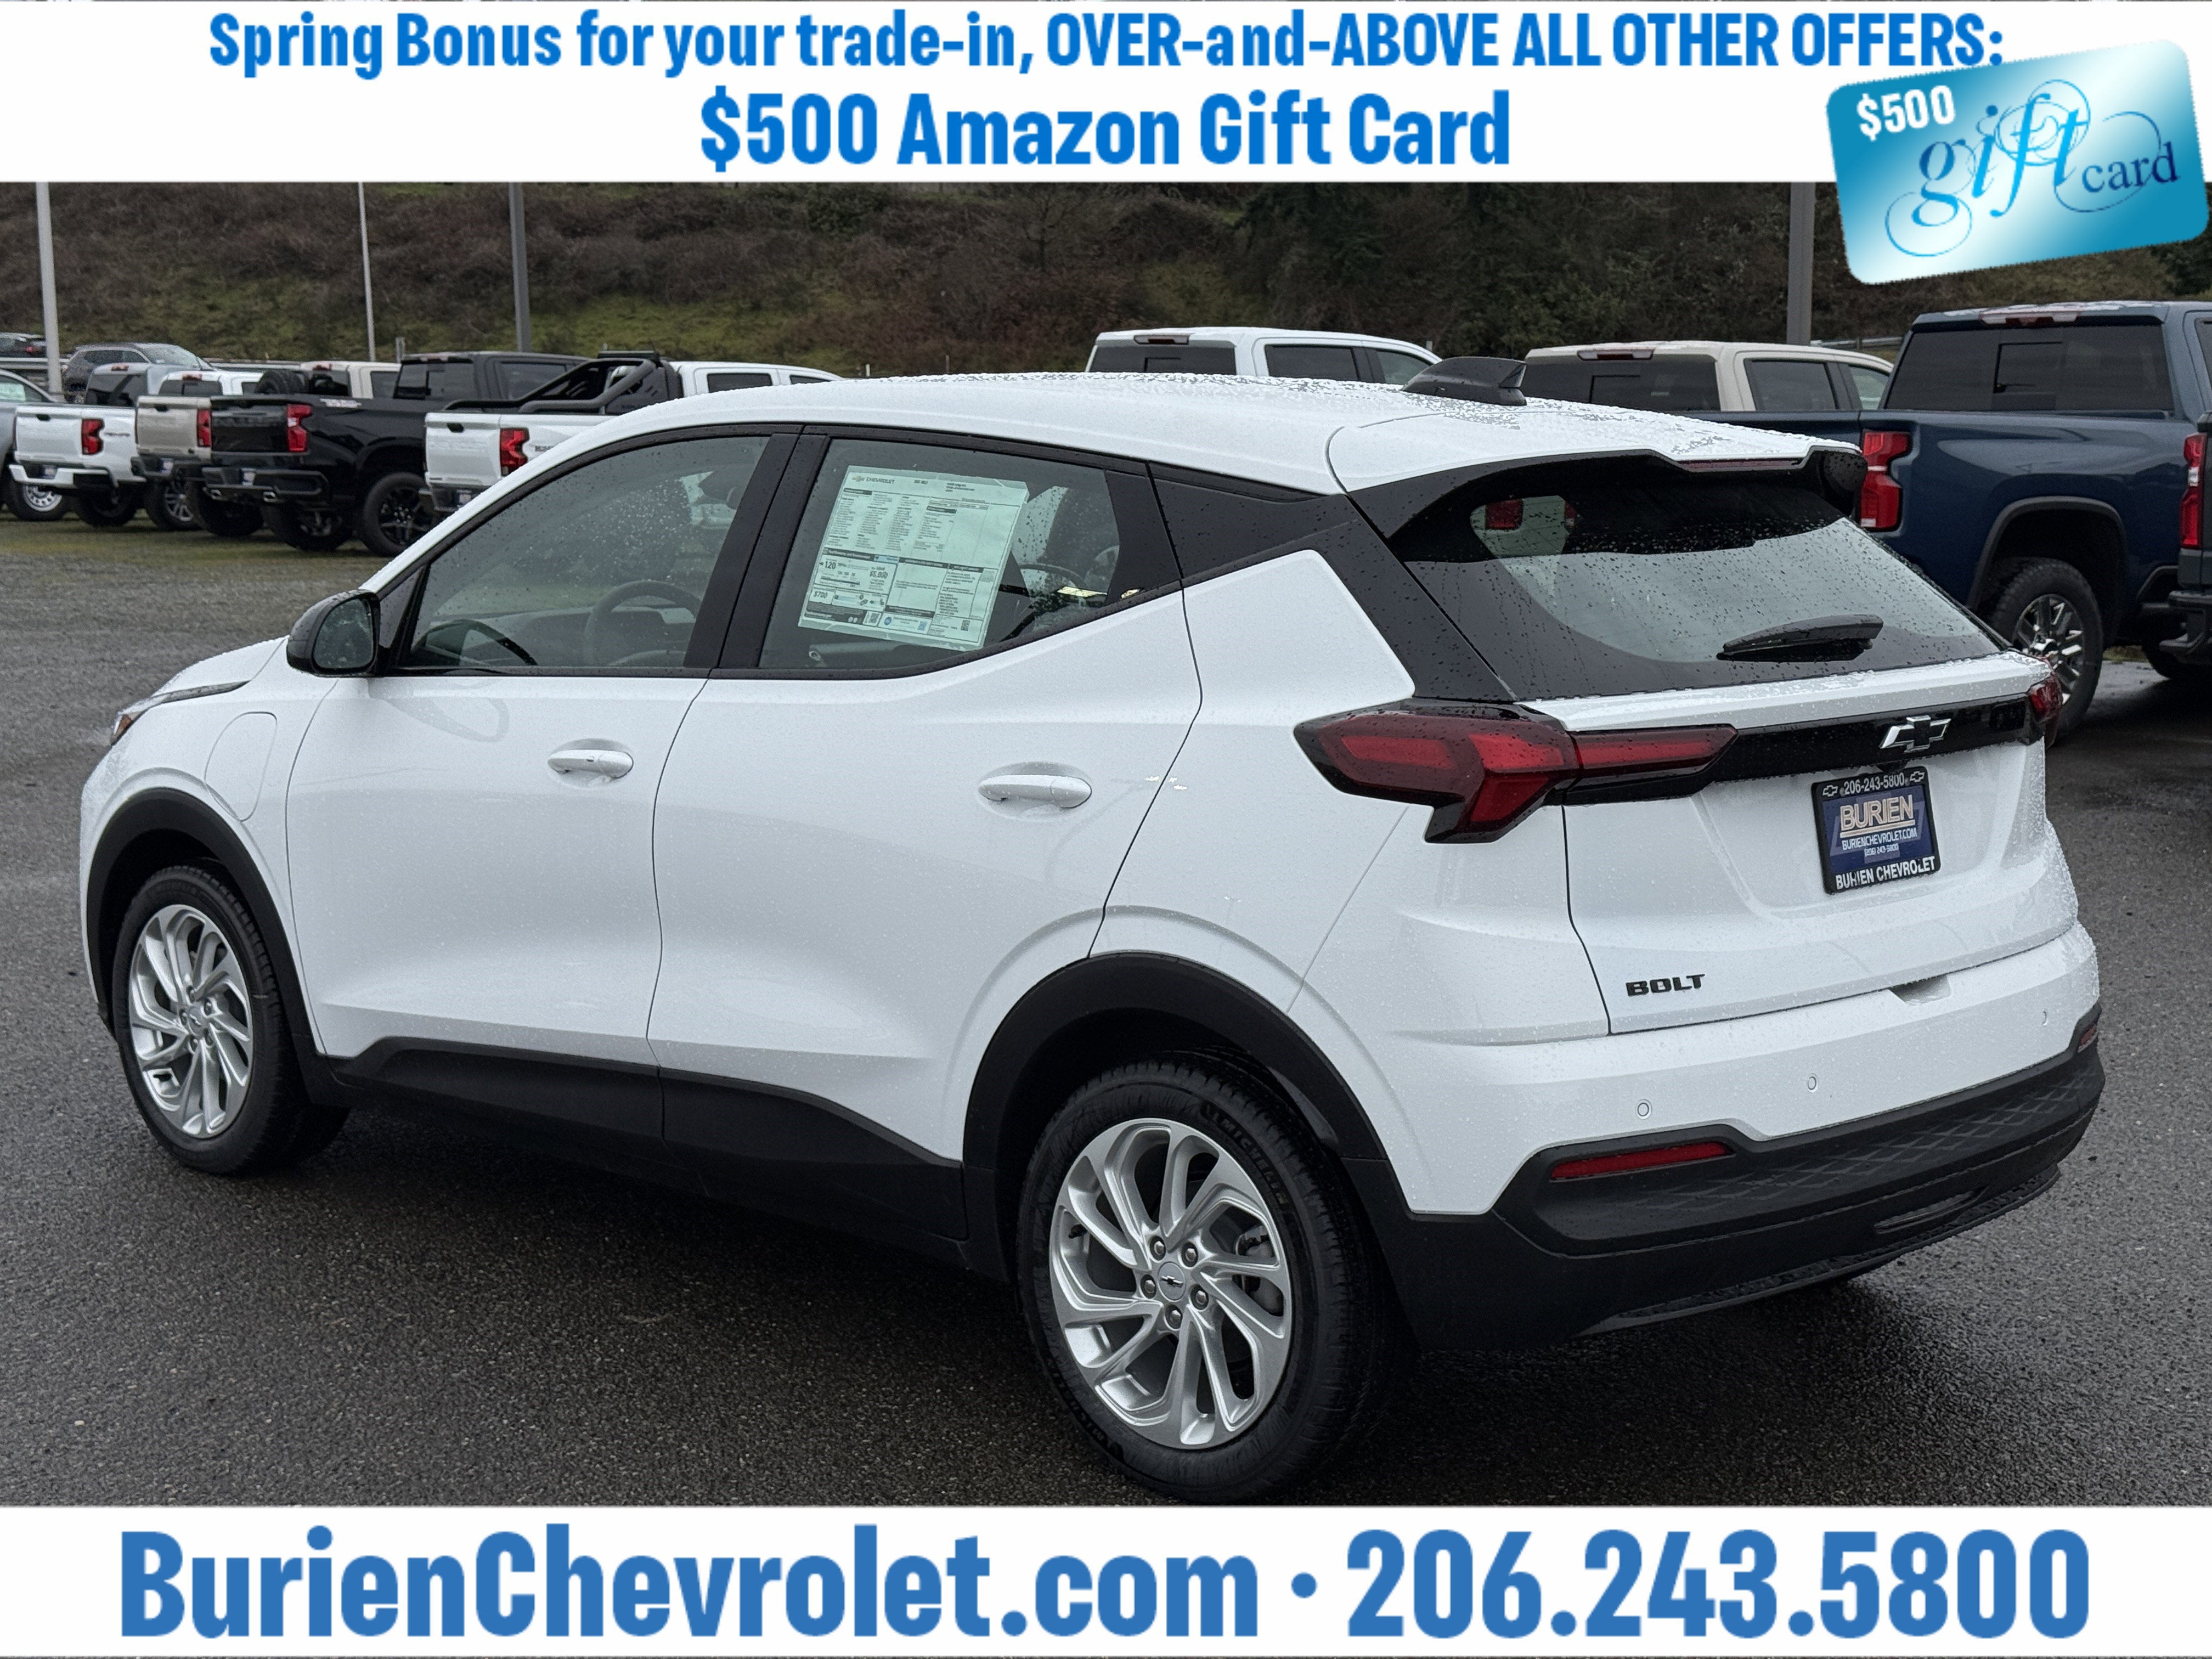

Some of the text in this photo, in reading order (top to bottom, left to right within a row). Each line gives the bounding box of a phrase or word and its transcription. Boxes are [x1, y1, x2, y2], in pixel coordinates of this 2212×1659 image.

[825, 561, 837, 570] 120
[1843, 772, 1905, 795] 206-243-5800
[1840, 794, 1914, 831] BURIEN
[1842, 827, 1918, 851] BURIENCHEVROLET.COM
[1626, 973, 1706, 997] BOLT
